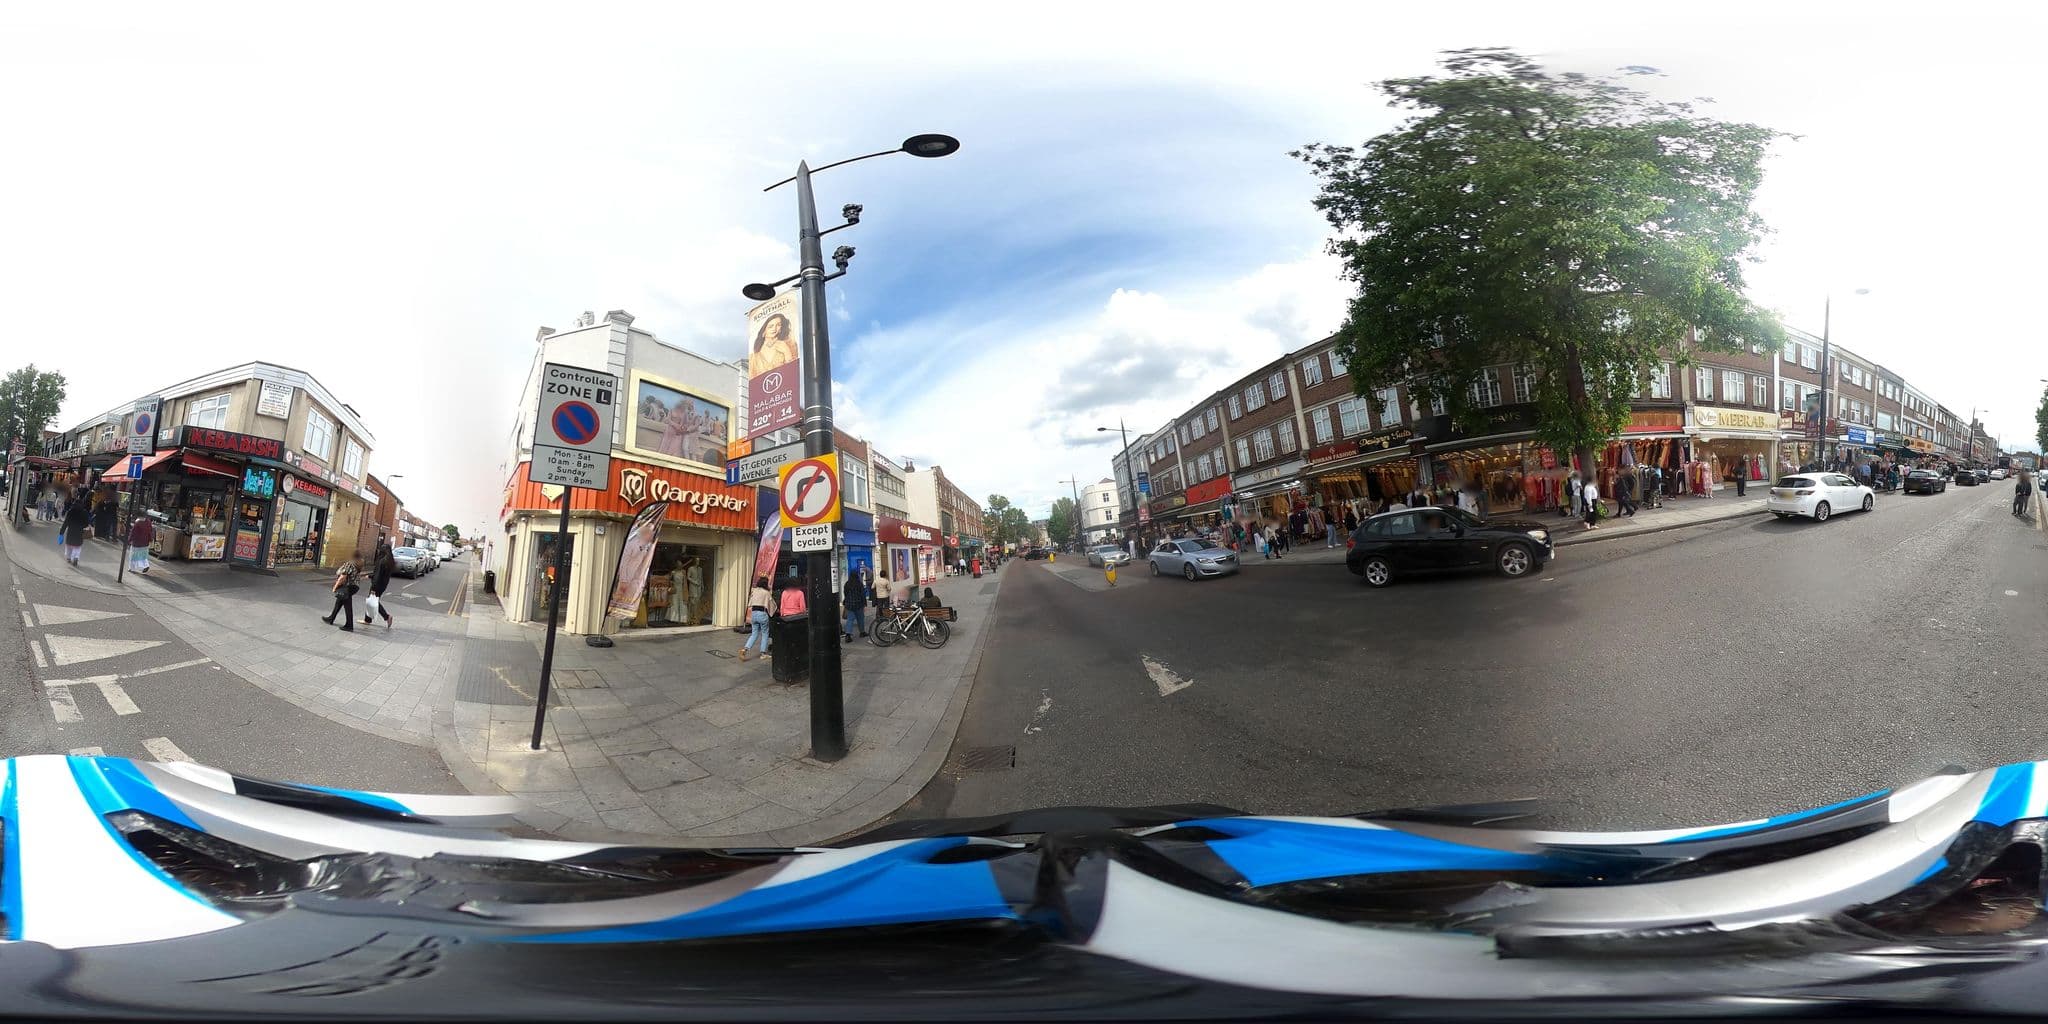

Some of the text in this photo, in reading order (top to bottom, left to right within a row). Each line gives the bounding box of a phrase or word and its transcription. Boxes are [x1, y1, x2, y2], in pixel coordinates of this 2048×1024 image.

[754, 299, 790, 321] SOUTHALL
[550, 369, 613, 388] Controlled
[547, 382, 592, 399] ZONE
[753, 390, 792, 409] MALABAR
[781, 406, 792, 417] 14
[1718, 412, 1764, 428] MEERAB
[191, 428, 280, 458] KEBABISH
[554, 449, 571, 458] Mon
[578, 453, 591, 461] Sat
[556, 466, 586, 477] Sunday
[741, 467, 772, 481] AVENUE
[294, 478, 327, 497] KEBABISH
[651, 479, 749, 514] Manyavar
[796, 525, 828, 537] Except
[797, 537, 827, 549] cycles
